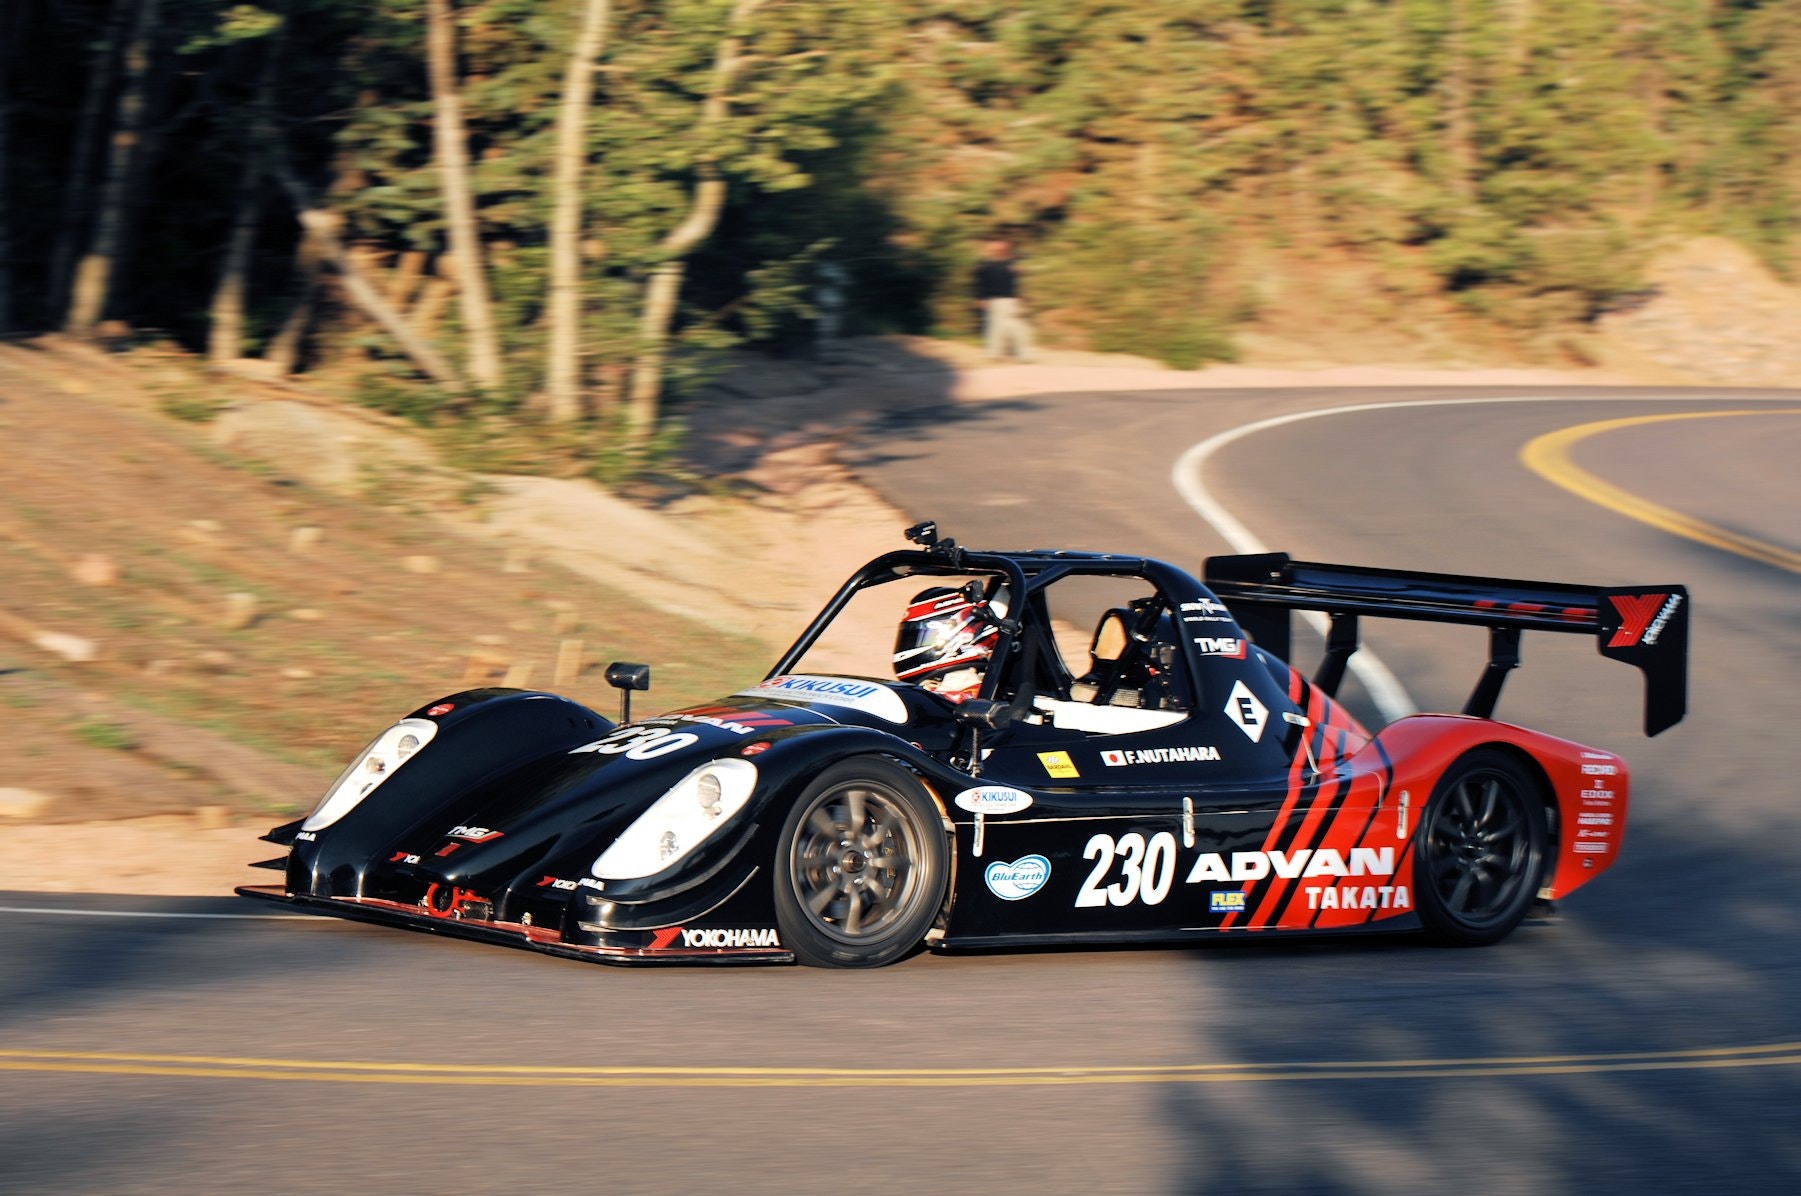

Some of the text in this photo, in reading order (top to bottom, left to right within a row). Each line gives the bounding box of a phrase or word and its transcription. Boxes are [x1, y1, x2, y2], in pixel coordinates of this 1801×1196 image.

[1193, 637, 1236, 653] TMG
[778, 679, 878, 698] KIKUSUI
[1235, 697, 1259, 725] E
[567, 726, 700, 761] 230
[1124, 746, 1221, 764] F.NUTAHARA
[981, 791, 1017, 802] KIKUSUI
[1074, 831, 1177, 908] 230
[1185, 847, 1395, 883] ADVAN
[991, 872, 1042, 881] BluEarth
[1211, 892, 1246, 906] FLEX
[1305, 886, 1410, 909] TAKATA
[681, 929, 781, 947] YOKOHAMA
